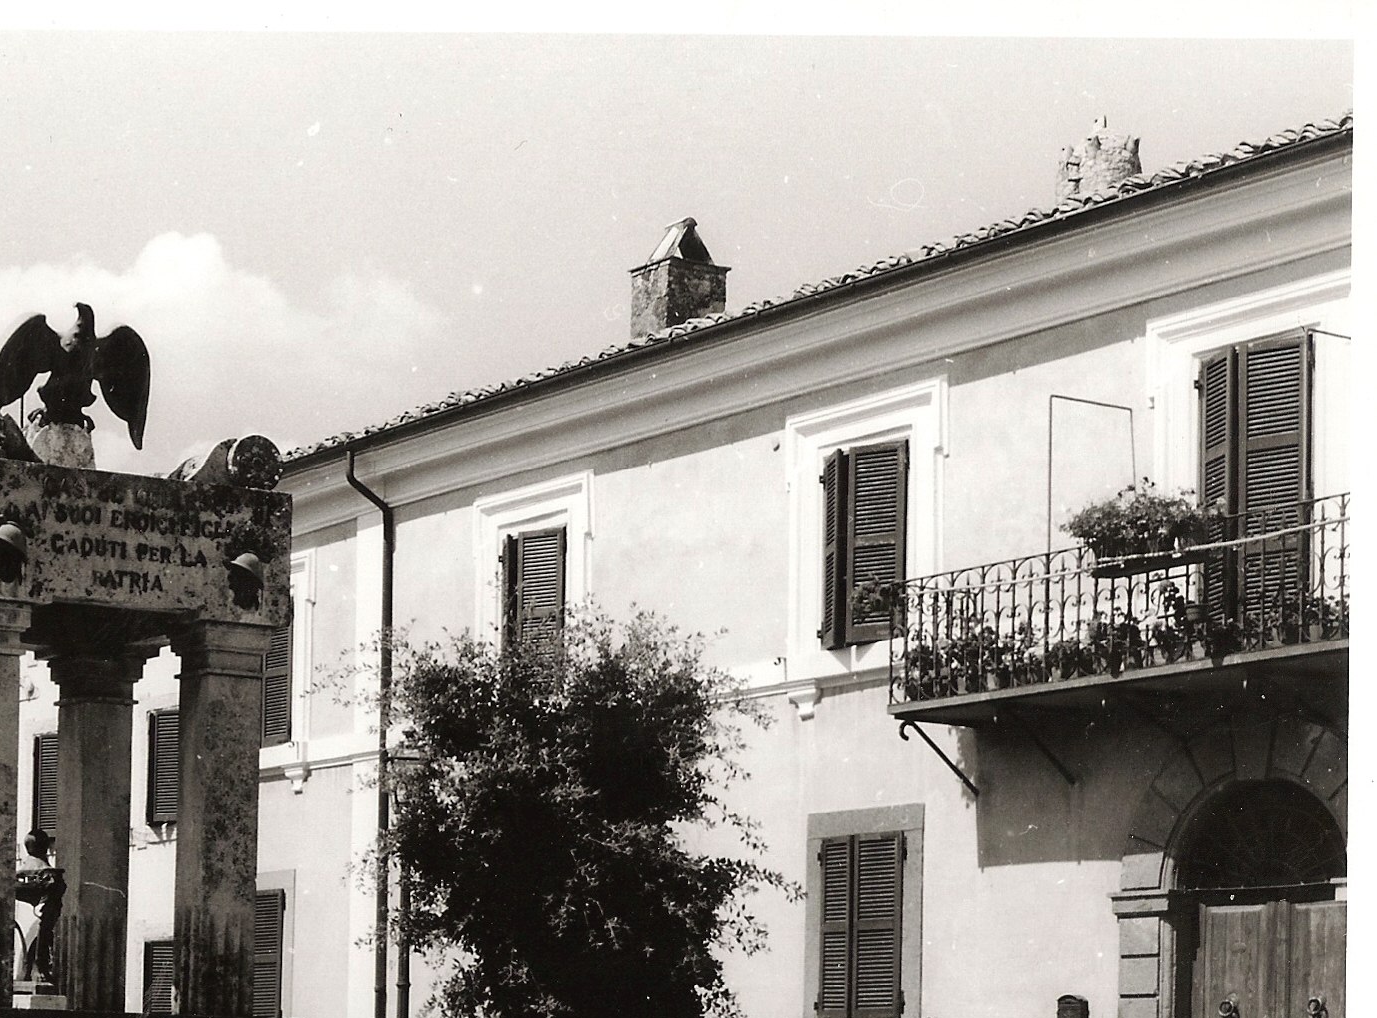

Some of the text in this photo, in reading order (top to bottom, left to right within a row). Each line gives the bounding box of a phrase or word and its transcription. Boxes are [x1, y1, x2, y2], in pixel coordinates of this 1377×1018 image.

[54, 503, 101, 525] SUOI
[51, 533, 208, 567] CADUTI PER LA
[92, 568, 164, 595] PATRIA
